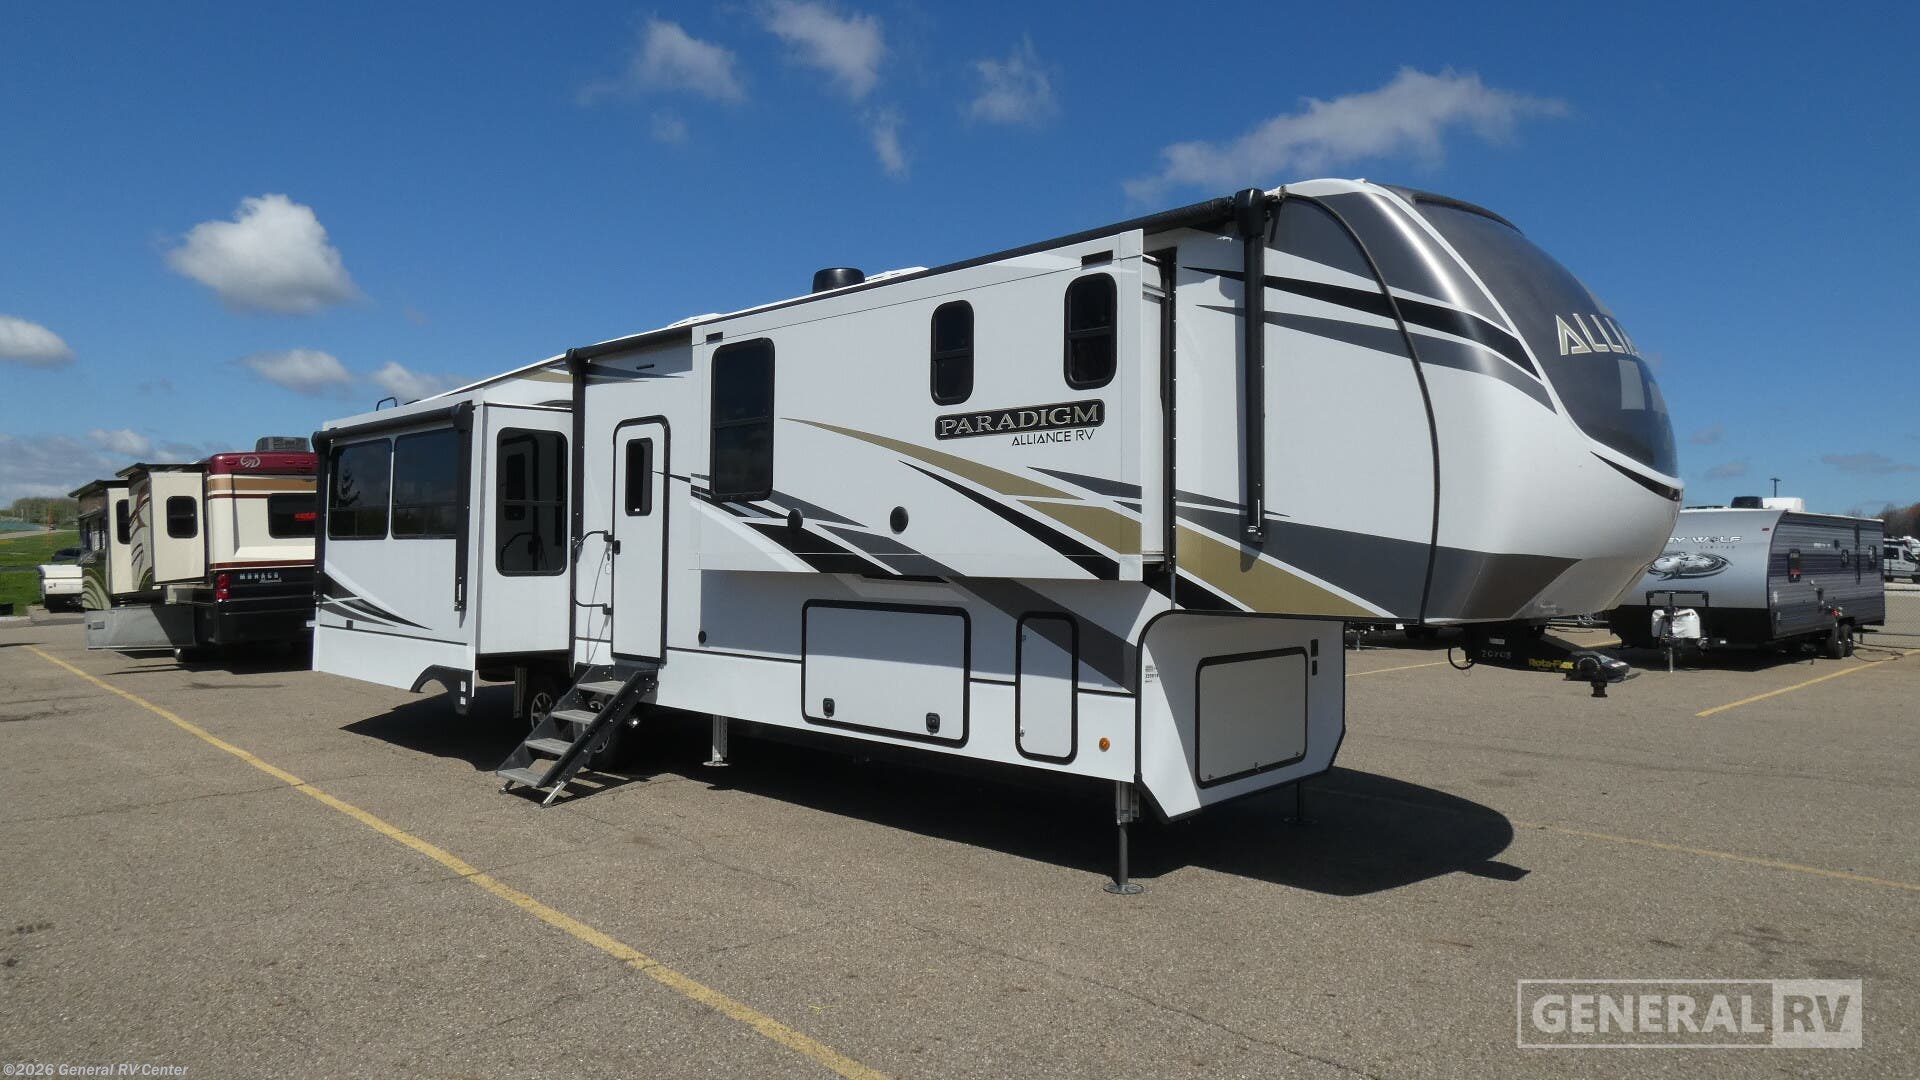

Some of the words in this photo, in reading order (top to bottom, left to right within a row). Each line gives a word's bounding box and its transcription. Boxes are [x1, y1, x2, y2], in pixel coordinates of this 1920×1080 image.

[1555, 313, 1639, 356] ALLI
[940, 404, 1099, 436] PARADIGM
[1011, 429, 1072, 447] ALLIANCE
[1075, 428, 1095, 441] RV
